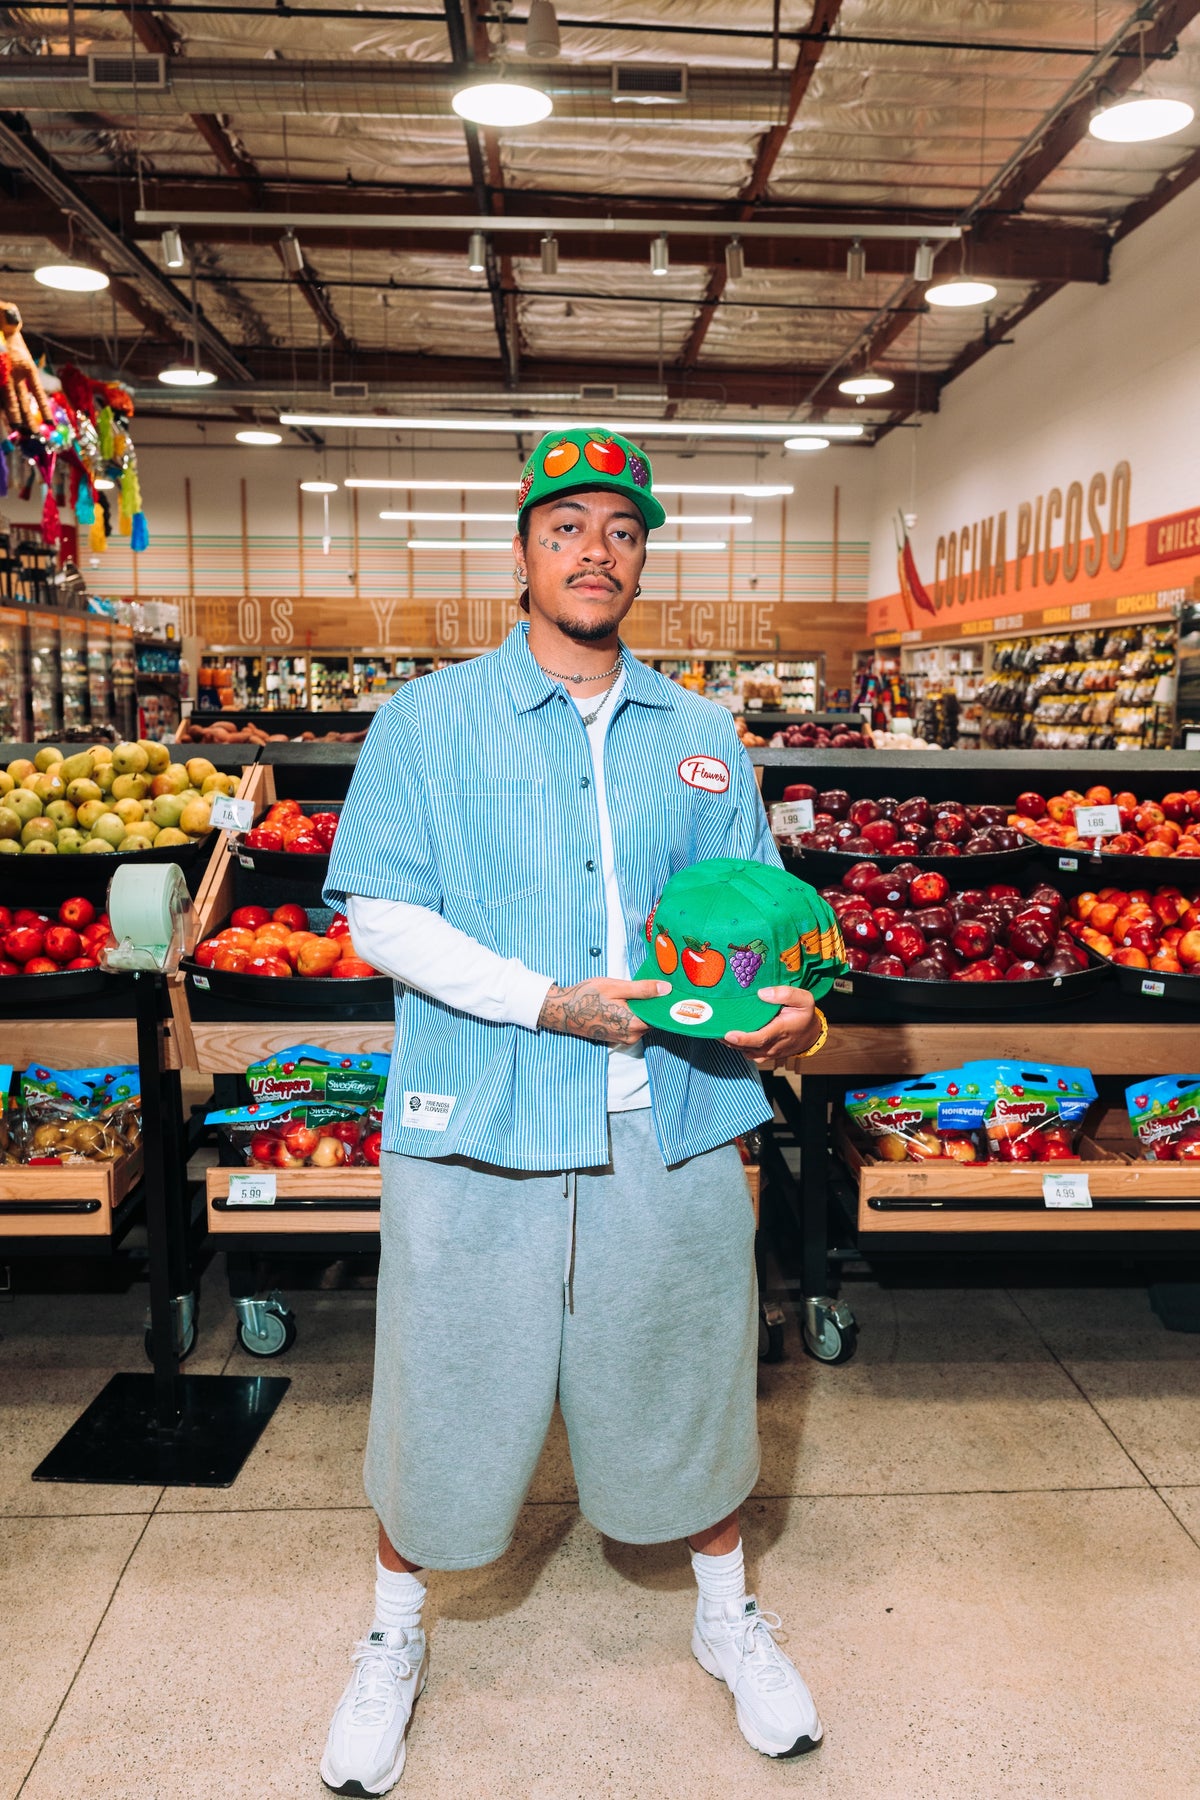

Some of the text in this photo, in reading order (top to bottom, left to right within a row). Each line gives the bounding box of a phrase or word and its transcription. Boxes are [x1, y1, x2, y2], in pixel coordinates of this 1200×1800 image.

[934, 459, 1132, 611] COCINA PICOSO
[1157, 516, 1200, 556] CHILES
[640, 602, 774, 648] ECHE
[687, 761, 726, 783] Flowers
[782, 814, 799, 825] 1.99
[1087, 818, 1104, 827] 1.69
[941, 1107, 984, 1117] HONEYCRIS
[241, 1189, 262, 1199] 5.99
[1055, 1188, 1076, 1198] 4.99
[369, 1631, 386, 1642] NIKE
